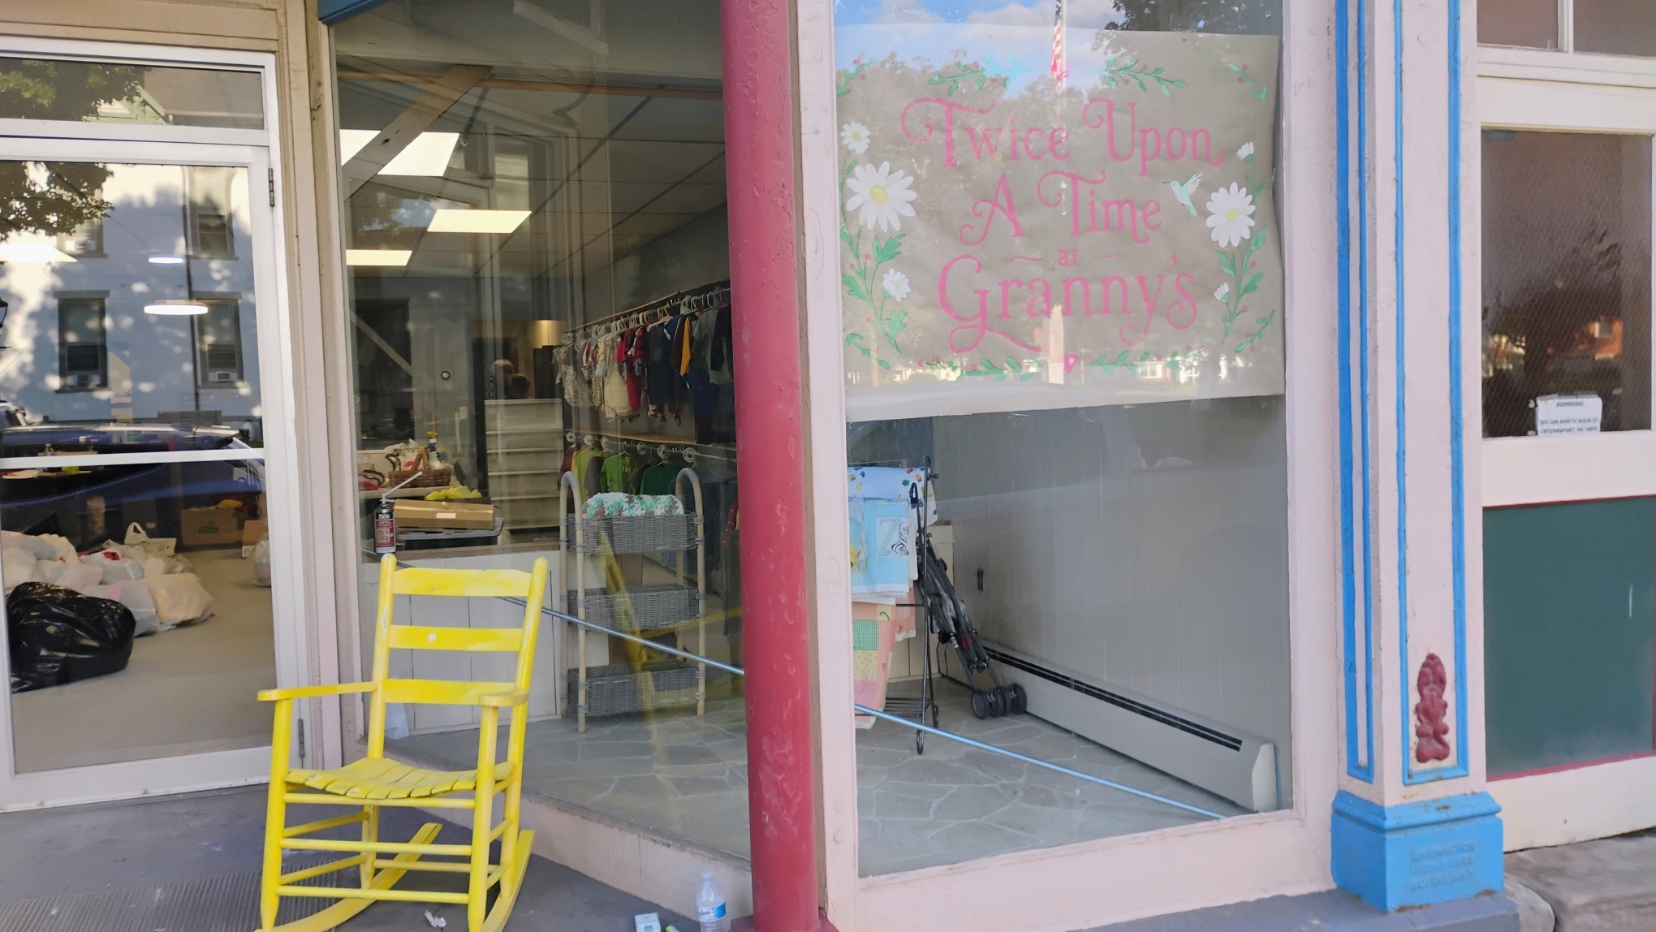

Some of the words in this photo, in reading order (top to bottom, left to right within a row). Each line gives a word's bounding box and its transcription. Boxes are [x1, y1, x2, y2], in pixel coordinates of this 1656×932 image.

[900, 97, 1071, 168] Twice
[1082, 98, 1225, 177] Upon
[959, 173, 1027, 246] A
[1037, 170, 1162, 245] Time
[1058, 247, 1079, 267] at
[937, 253, 1199, 354] Granny's
